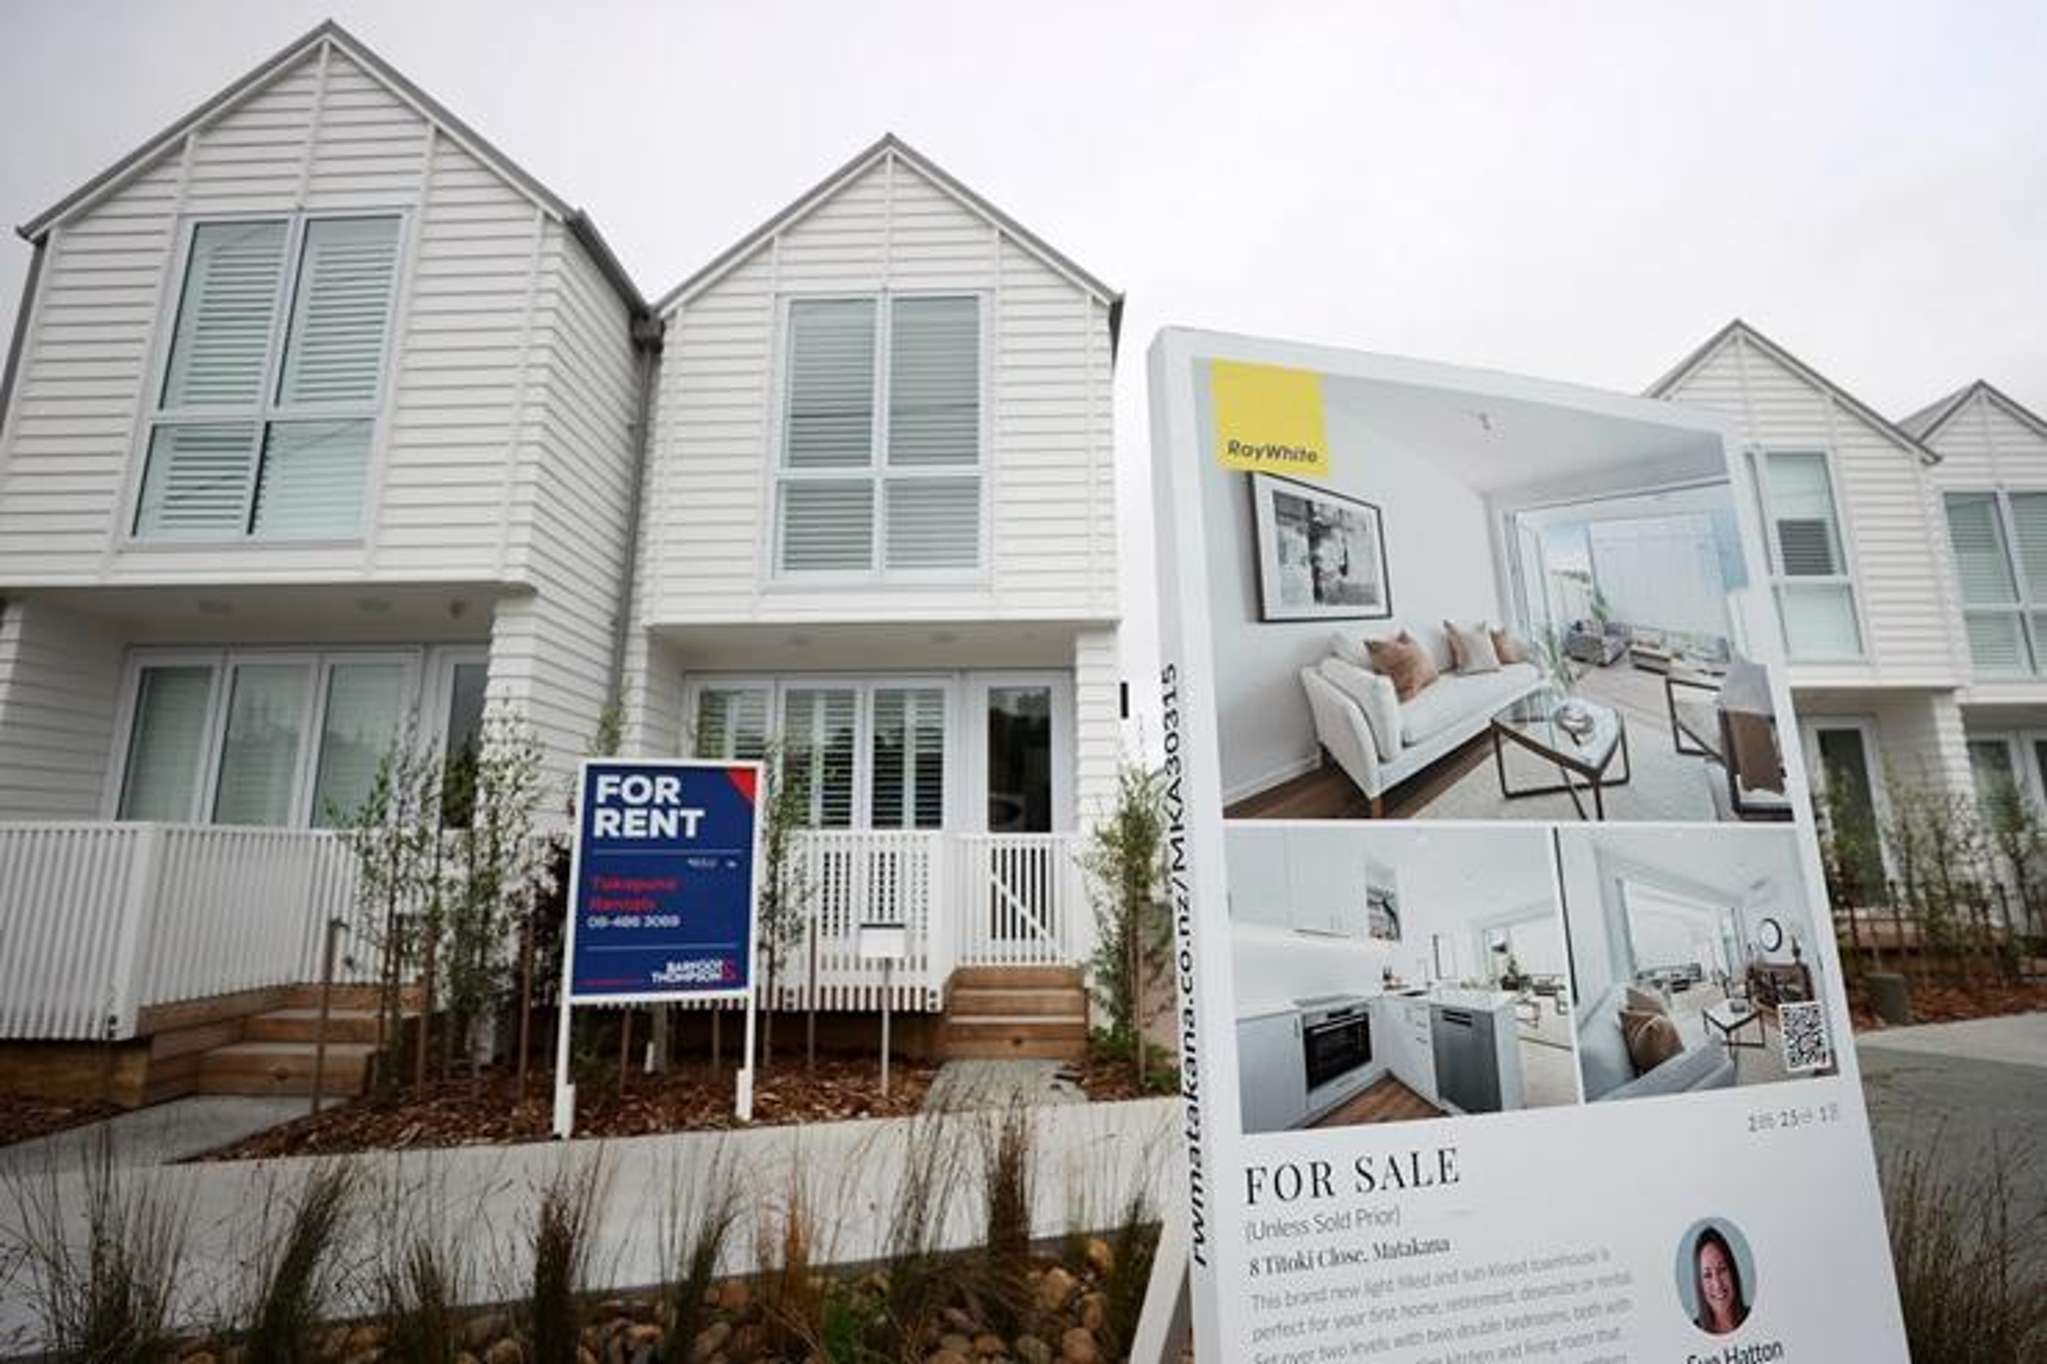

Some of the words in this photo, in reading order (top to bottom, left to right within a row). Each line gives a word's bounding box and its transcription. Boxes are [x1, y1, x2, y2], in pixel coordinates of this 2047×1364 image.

[1228, 438, 1319, 463] RayWhite
[597, 774, 682, 806] FOR
[593, 807, 705, 839] RENT
[1160, 663, 1208, 1268] rwmatakana.co.nz/MKA30315
[1246, 1161, 1336, 1205] FOR
[1354, 1147, 1461, 1194] SALE
[1245, 1216, 1310, 1244] (Unless
[1313, 1212, 1351, 1235] Sold
[1356, 1205, 1401, 1228] Prior)
[1249, 1257, 1261, 1276] 8
[1372, 1237, 1451, 1261] Matakana
[1252, 1320, 1306, 1344] perfect
[1332, 1311, 1366, 1332] your
[1318, 1344, 1349, 1362] two
[1722, 1340, 1784, 1364] Hatton
